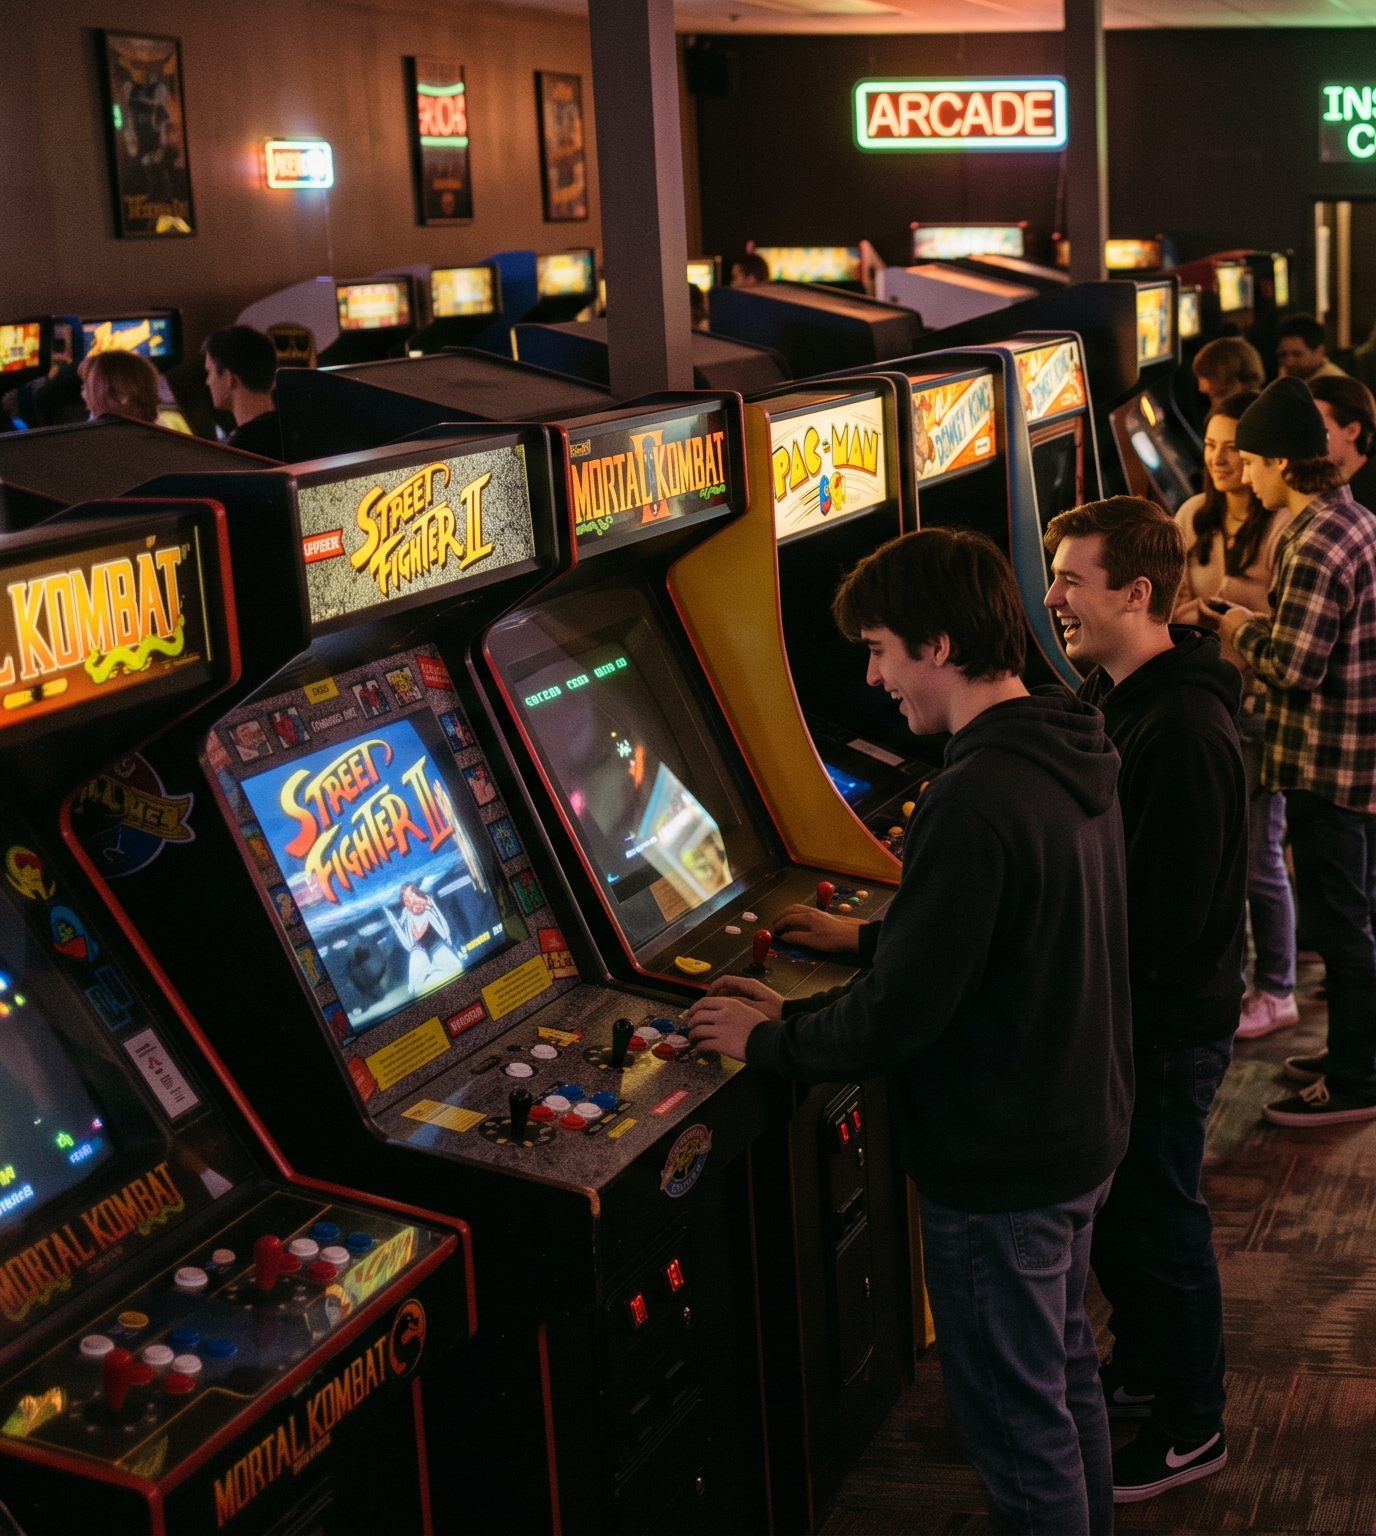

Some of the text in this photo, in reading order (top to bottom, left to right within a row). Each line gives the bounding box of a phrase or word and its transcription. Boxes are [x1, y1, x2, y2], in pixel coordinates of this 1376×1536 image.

[867, 91, 1055, 138] ARCADE
[350, 461, 451, 570] STREET
[571, 451, 653, 525] MORTAL
[653, 431, 725, 501] KOMBAT
[772, 422, 880, 503] PAC-MAN
[369, 472, 494, 595] FIGHTER II
[7, 546, 182, 681] KOMBAT
[280, 739, 393, 858] STREET
[304, 783, 428, 904] FIGHTER
[401, 755, 454, 852] II
[80, 1160, 183, 1251] KOMBAT
[213, 1334, 387, 1529] MORTAL KOMBAT
